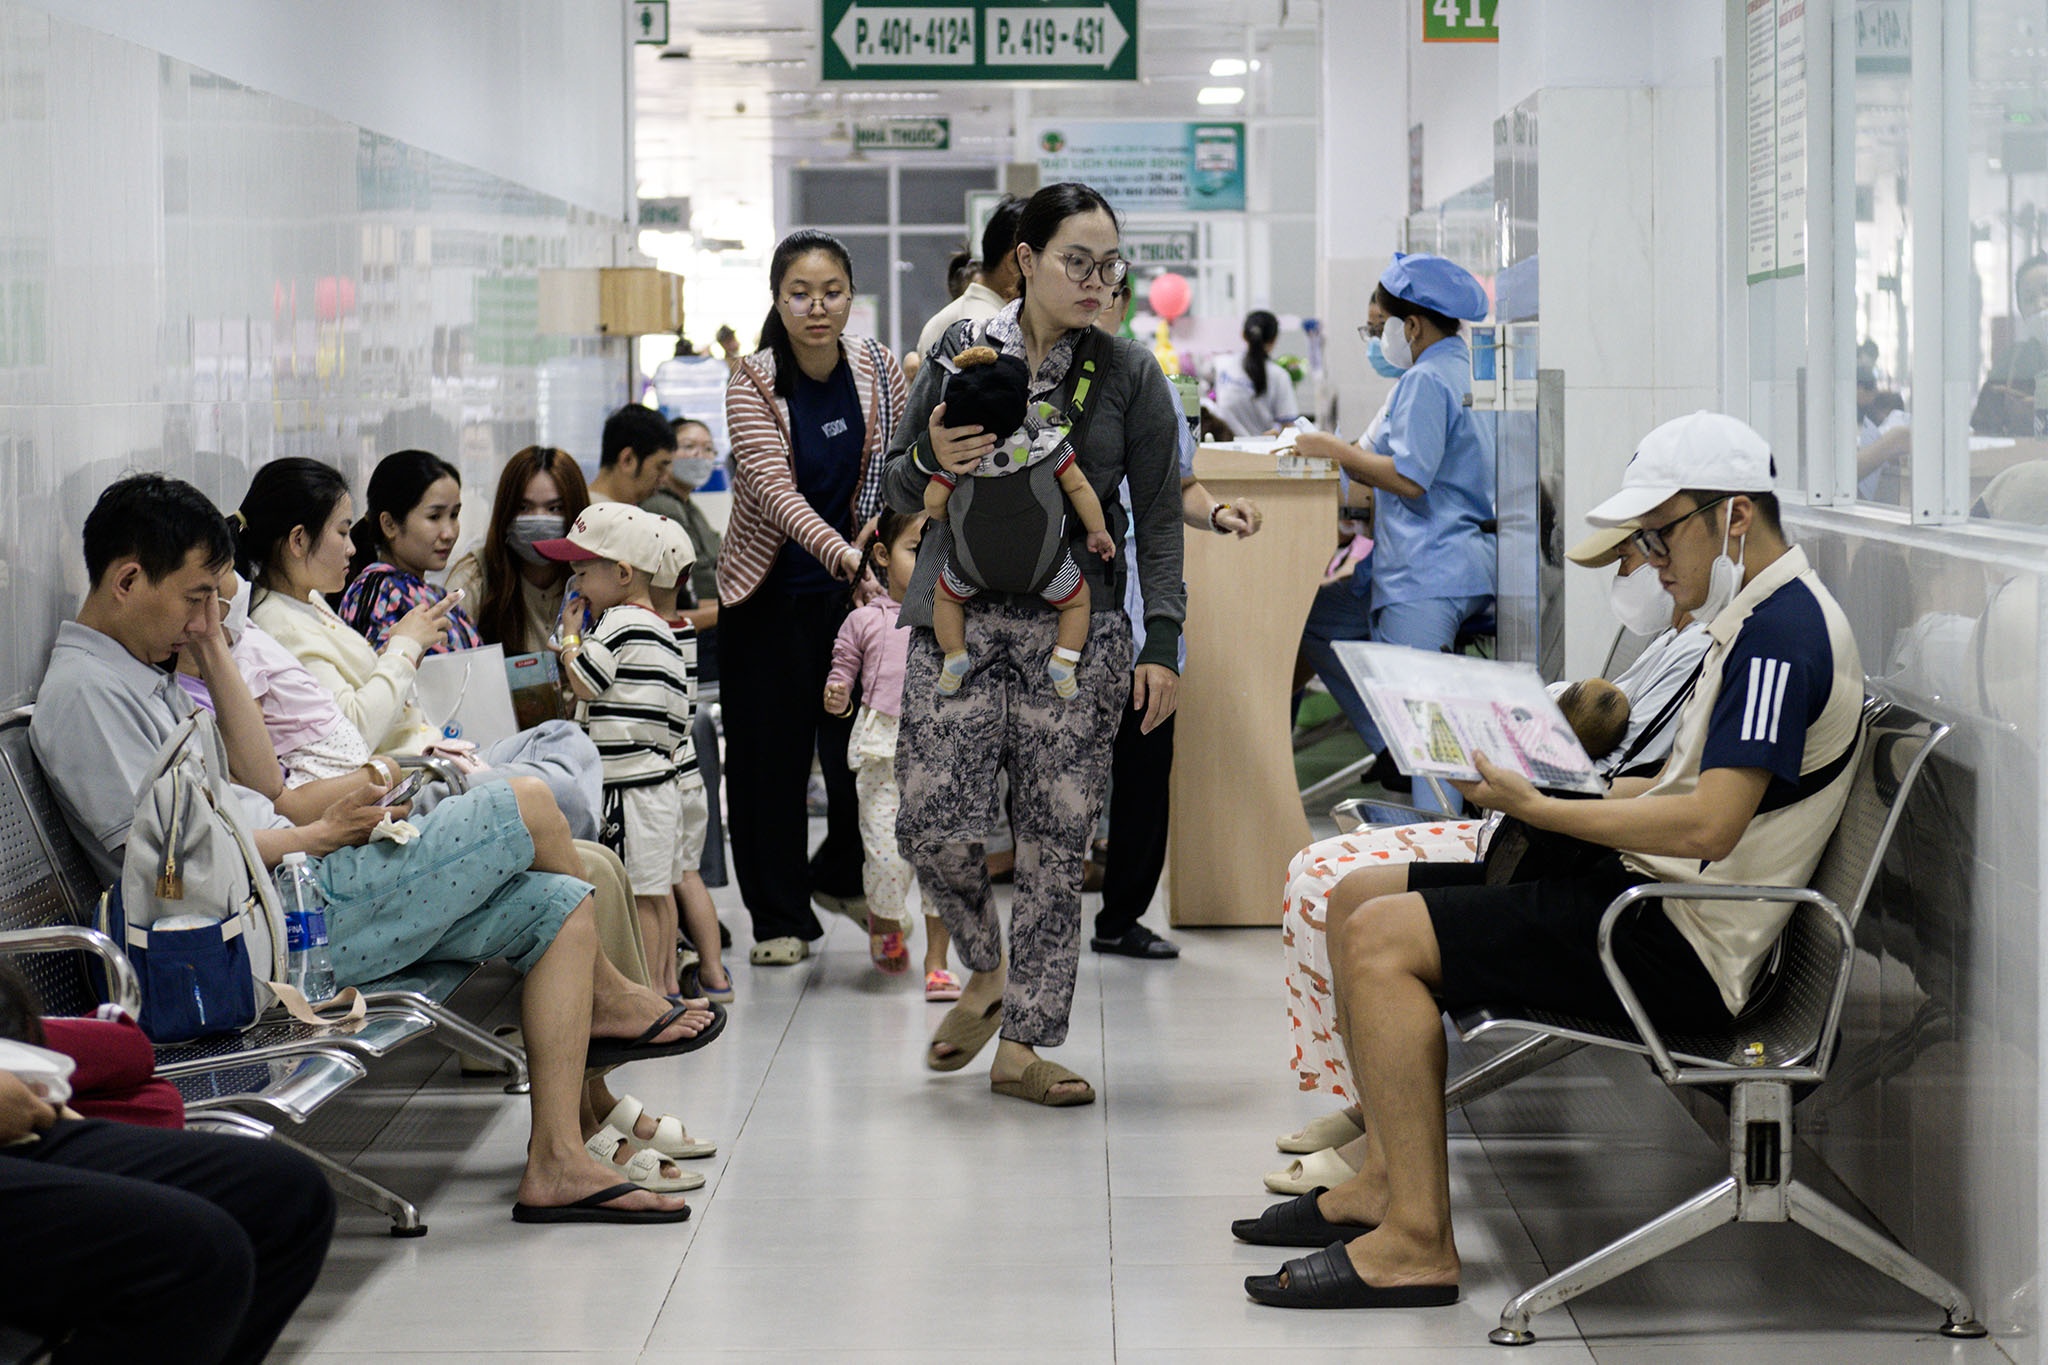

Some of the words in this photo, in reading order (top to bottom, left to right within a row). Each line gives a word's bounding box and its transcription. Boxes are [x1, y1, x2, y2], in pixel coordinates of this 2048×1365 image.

[1433, 0, 1499, 27] 41
[856, 18, 874, 54] P.
[998, 18, 1016, 54] P.
